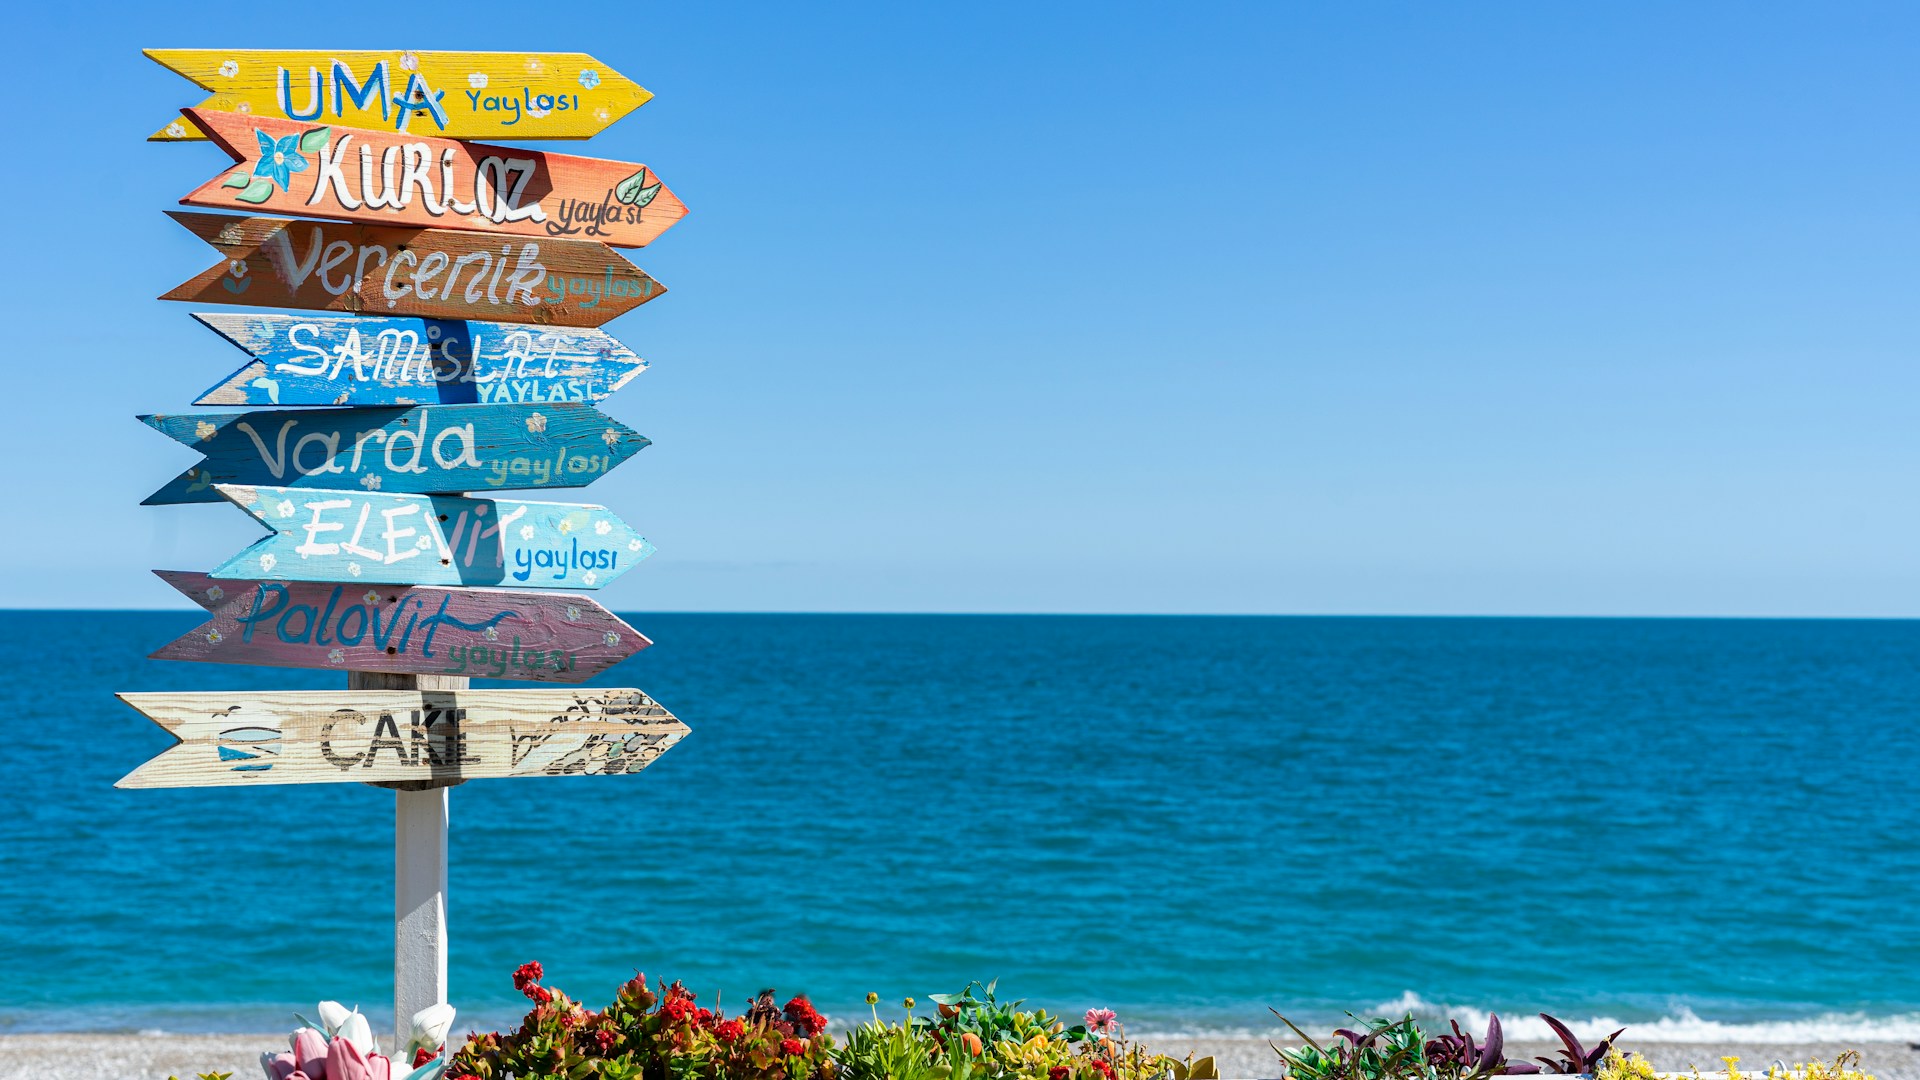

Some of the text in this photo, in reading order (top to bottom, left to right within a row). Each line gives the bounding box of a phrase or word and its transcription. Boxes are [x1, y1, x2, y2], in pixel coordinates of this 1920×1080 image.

[277, 58, 450, 135] UMA
[263, 225, 547, 309] Verçenik
[236, 409, 484, 479] Varda
